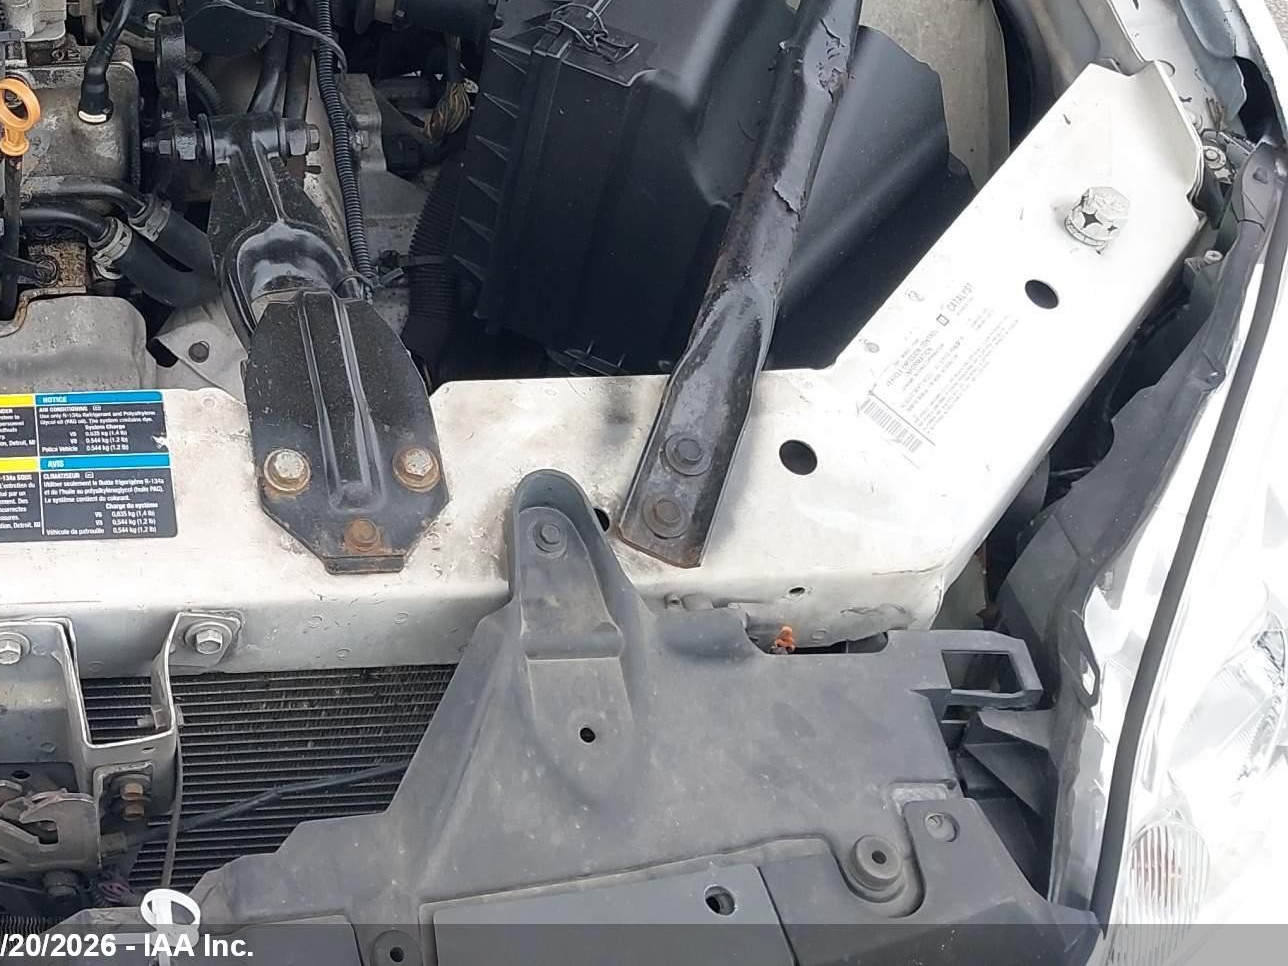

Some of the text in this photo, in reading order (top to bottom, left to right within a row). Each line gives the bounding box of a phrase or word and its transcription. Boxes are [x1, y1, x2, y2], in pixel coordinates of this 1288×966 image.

[945, 282, 976, 313] CATALYST
[42, 395, 67, 403] NOTICE
[47, 459, 63, 467] AVIS
[52, 496, 75, 504] système
[105, 501, 158, 510] Charge système
